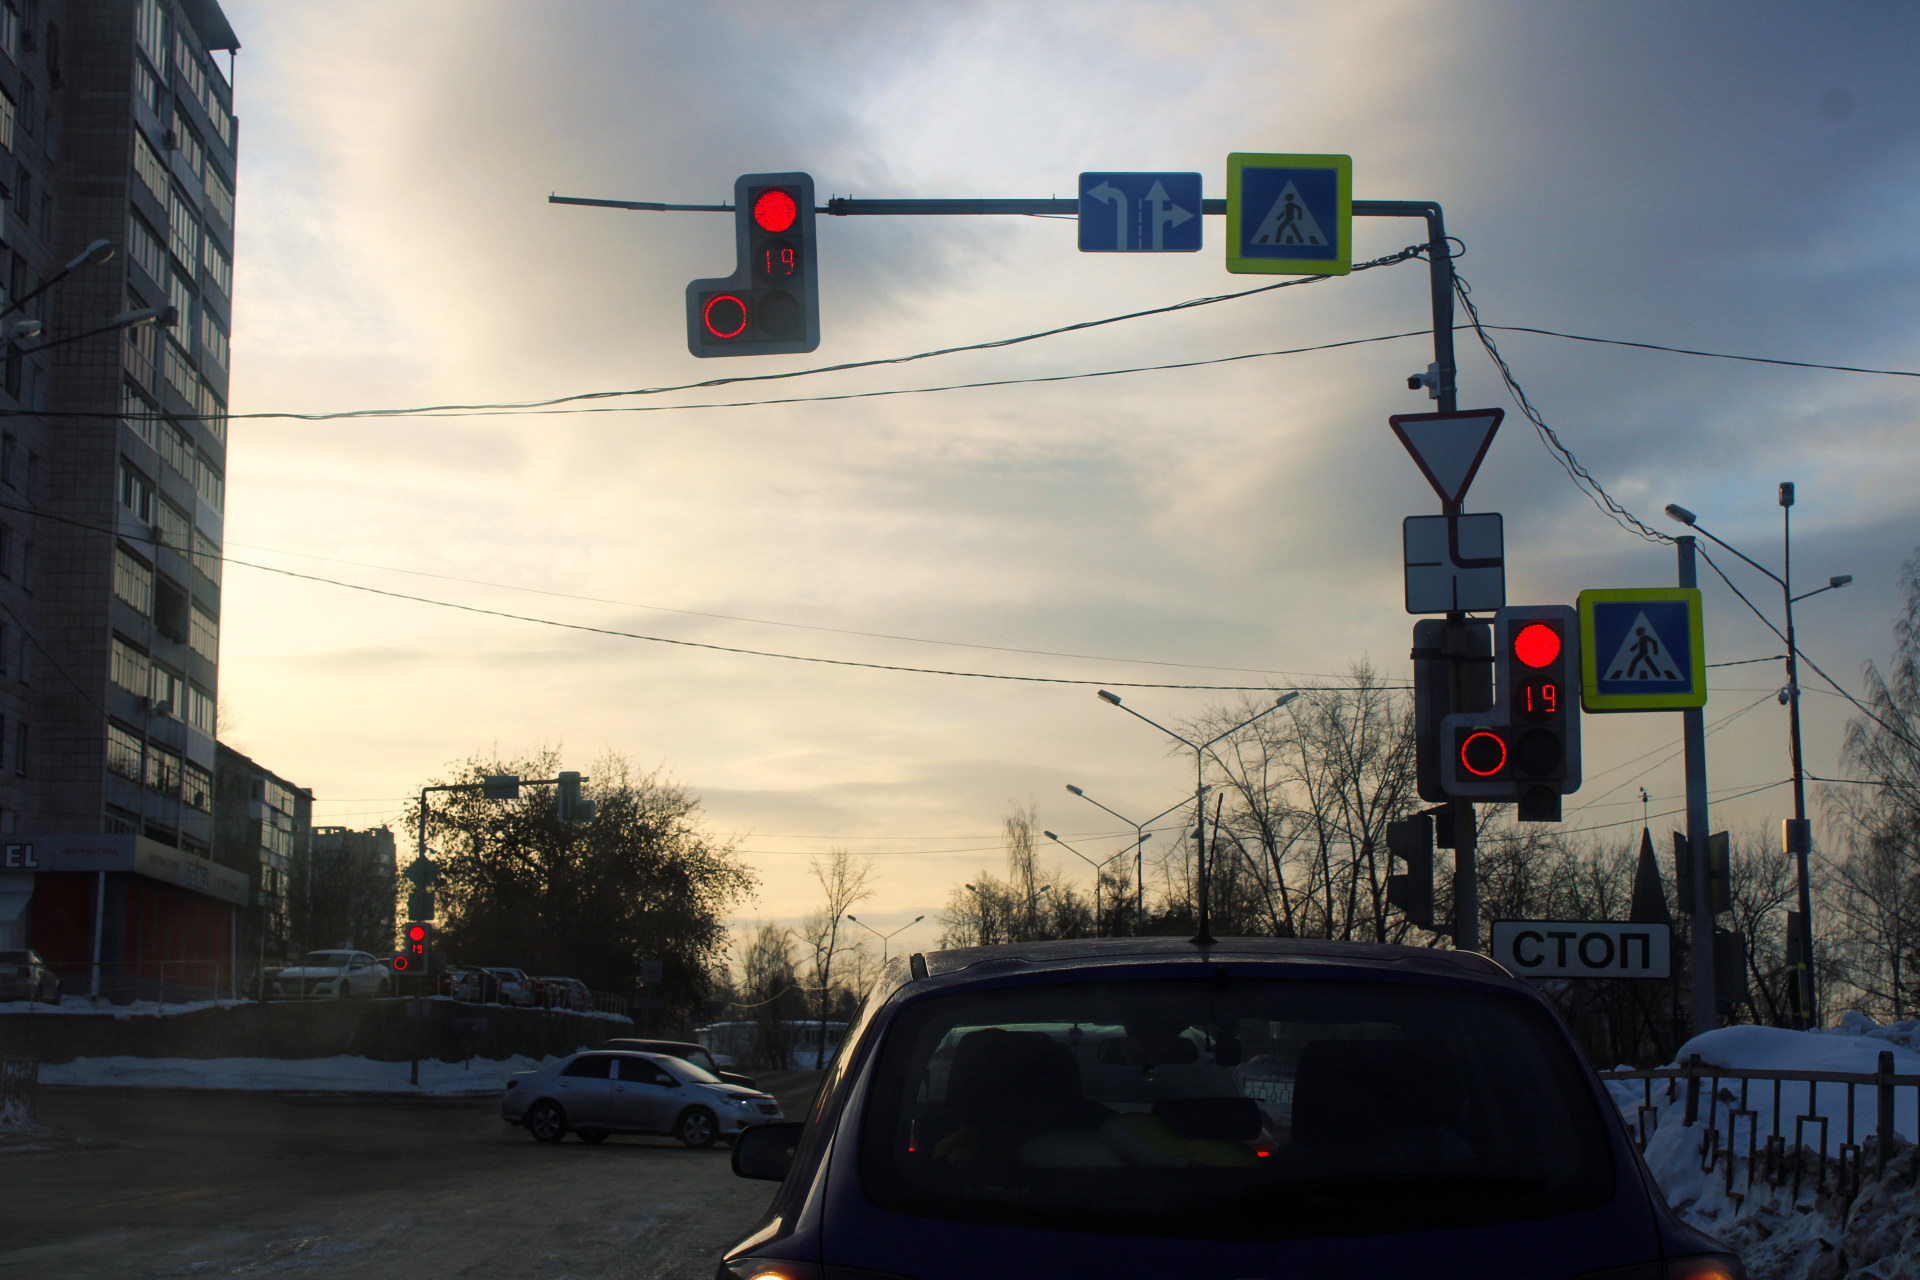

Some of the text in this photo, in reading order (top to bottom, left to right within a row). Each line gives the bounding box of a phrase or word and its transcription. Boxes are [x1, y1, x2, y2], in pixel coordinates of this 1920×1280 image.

[766, 248, 794, 274] 19
[1526, 684, 1556, 712] 19
[0, 842, 39, 869] EL
[62, 847, 119, 857] ФУРНИТУРА
[1512, 930, 1650, 969] СТОП
